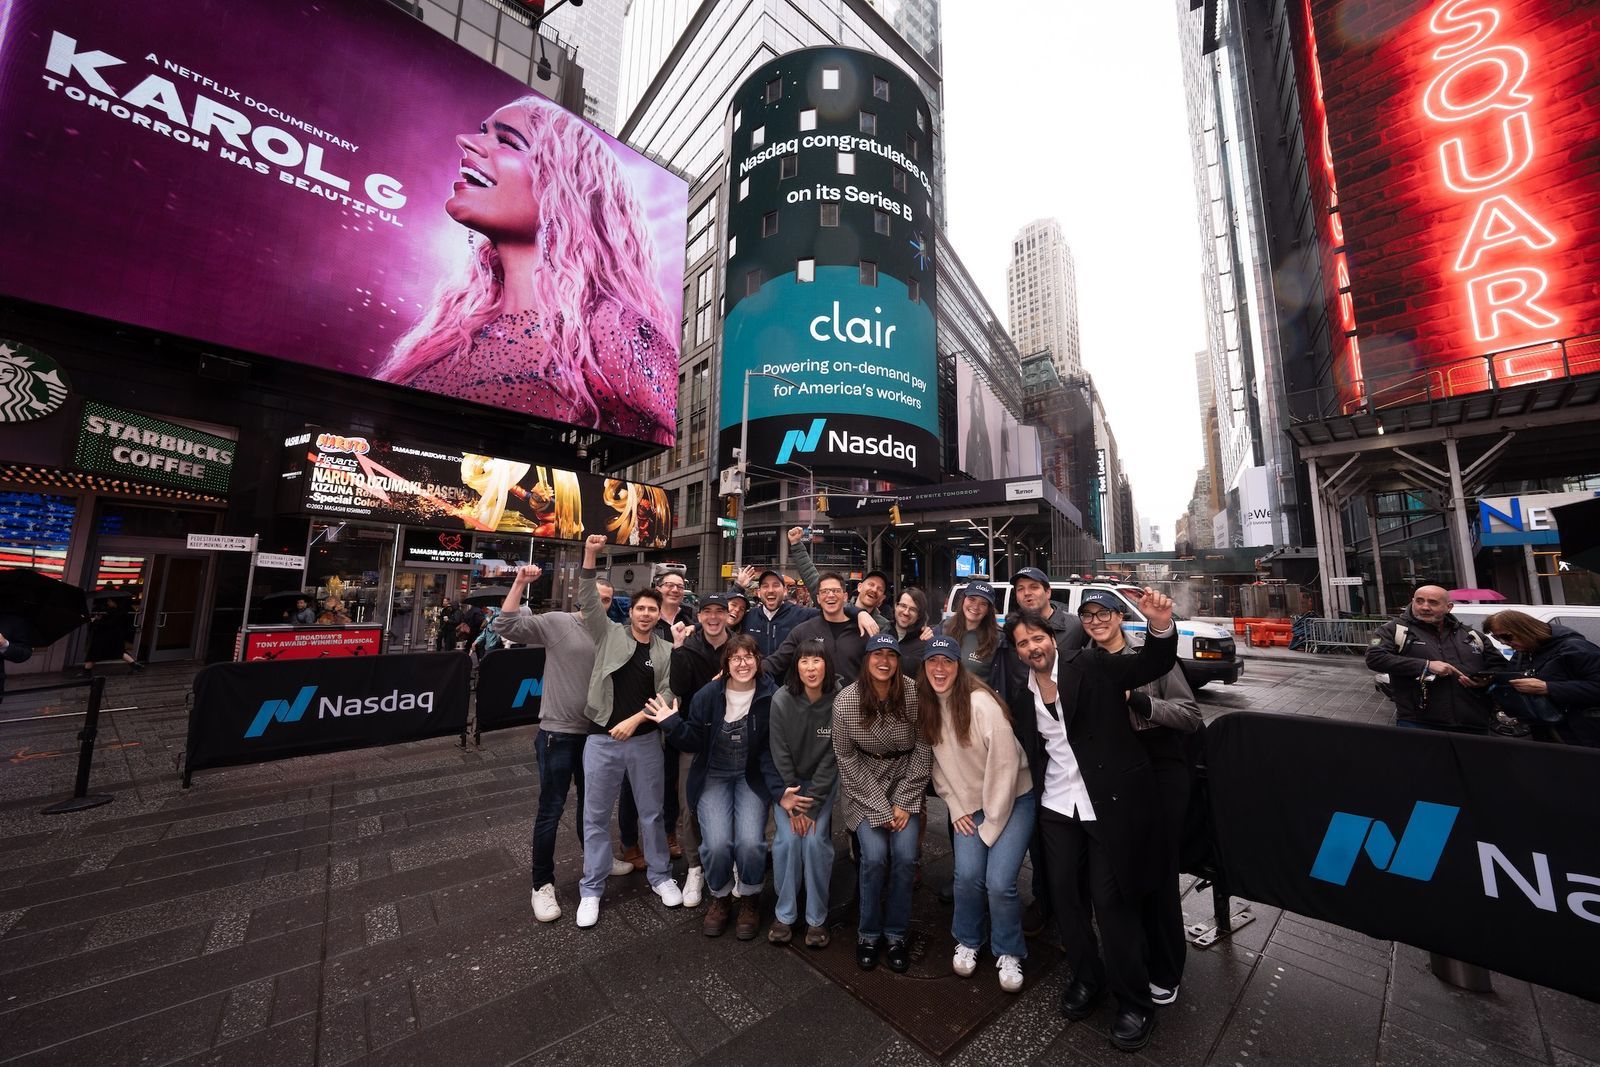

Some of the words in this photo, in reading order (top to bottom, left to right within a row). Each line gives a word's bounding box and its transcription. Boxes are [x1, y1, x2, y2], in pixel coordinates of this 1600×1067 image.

[145, 53, 159, 64] A
[164, 60, 241, 101] NETFLIX
[244, 96, 359, 153] DOCUMENTARY
[44, 30, 351, 191] KAROL
[364, 173, 407, 210] G
[42, 74, 210, 152] TOMORROW
[219, 148, 271, 175] WAS
[279, 170, 404, 228] BEAUTIFUL
[739, 138, 799, 177] Nasdaq
[802, 134, 919, 178] congratulates
[786, 189, 811, 204] on
[816, 184, 841, 200] its
[844, 185, 900, 216] Series
[903, 203, 913, 222] B
[809, 301, 896, 349] clair
[763, 358, 829, 376] Powering
[833, 361, 910, 384] on-demand
[911, 376, 927, 393] pay
[773, 384, 794, 398] for
[798, 381, 874, 397] America's
[876, 387, 922, 409] workers
[86, 414, 234, 465] STARBUCKS
[317, 433, 369, 453] NARUTO
[828, 430, 917, 468] Nasdaq
[112, 445, 206, 480] COFFEE
[316, 453, 359, 466] Figuarts
[310, 482, 353, 496] KIZUNA
[312, 467, 365, 487] NARUTO
[368, 475, 421, 495] UZUMAKI
[354, 496, 380, 508] Color
[190, 535, 221, 543] PEDESTRIAN
[975, 584, 990, 594] clair
[343, 637, 374, 645] MUSICAL
[877, 636, 894, 645] clair
[932, 640, 950, 648] clair
[318, 689, 435, 719] Nasdaq
